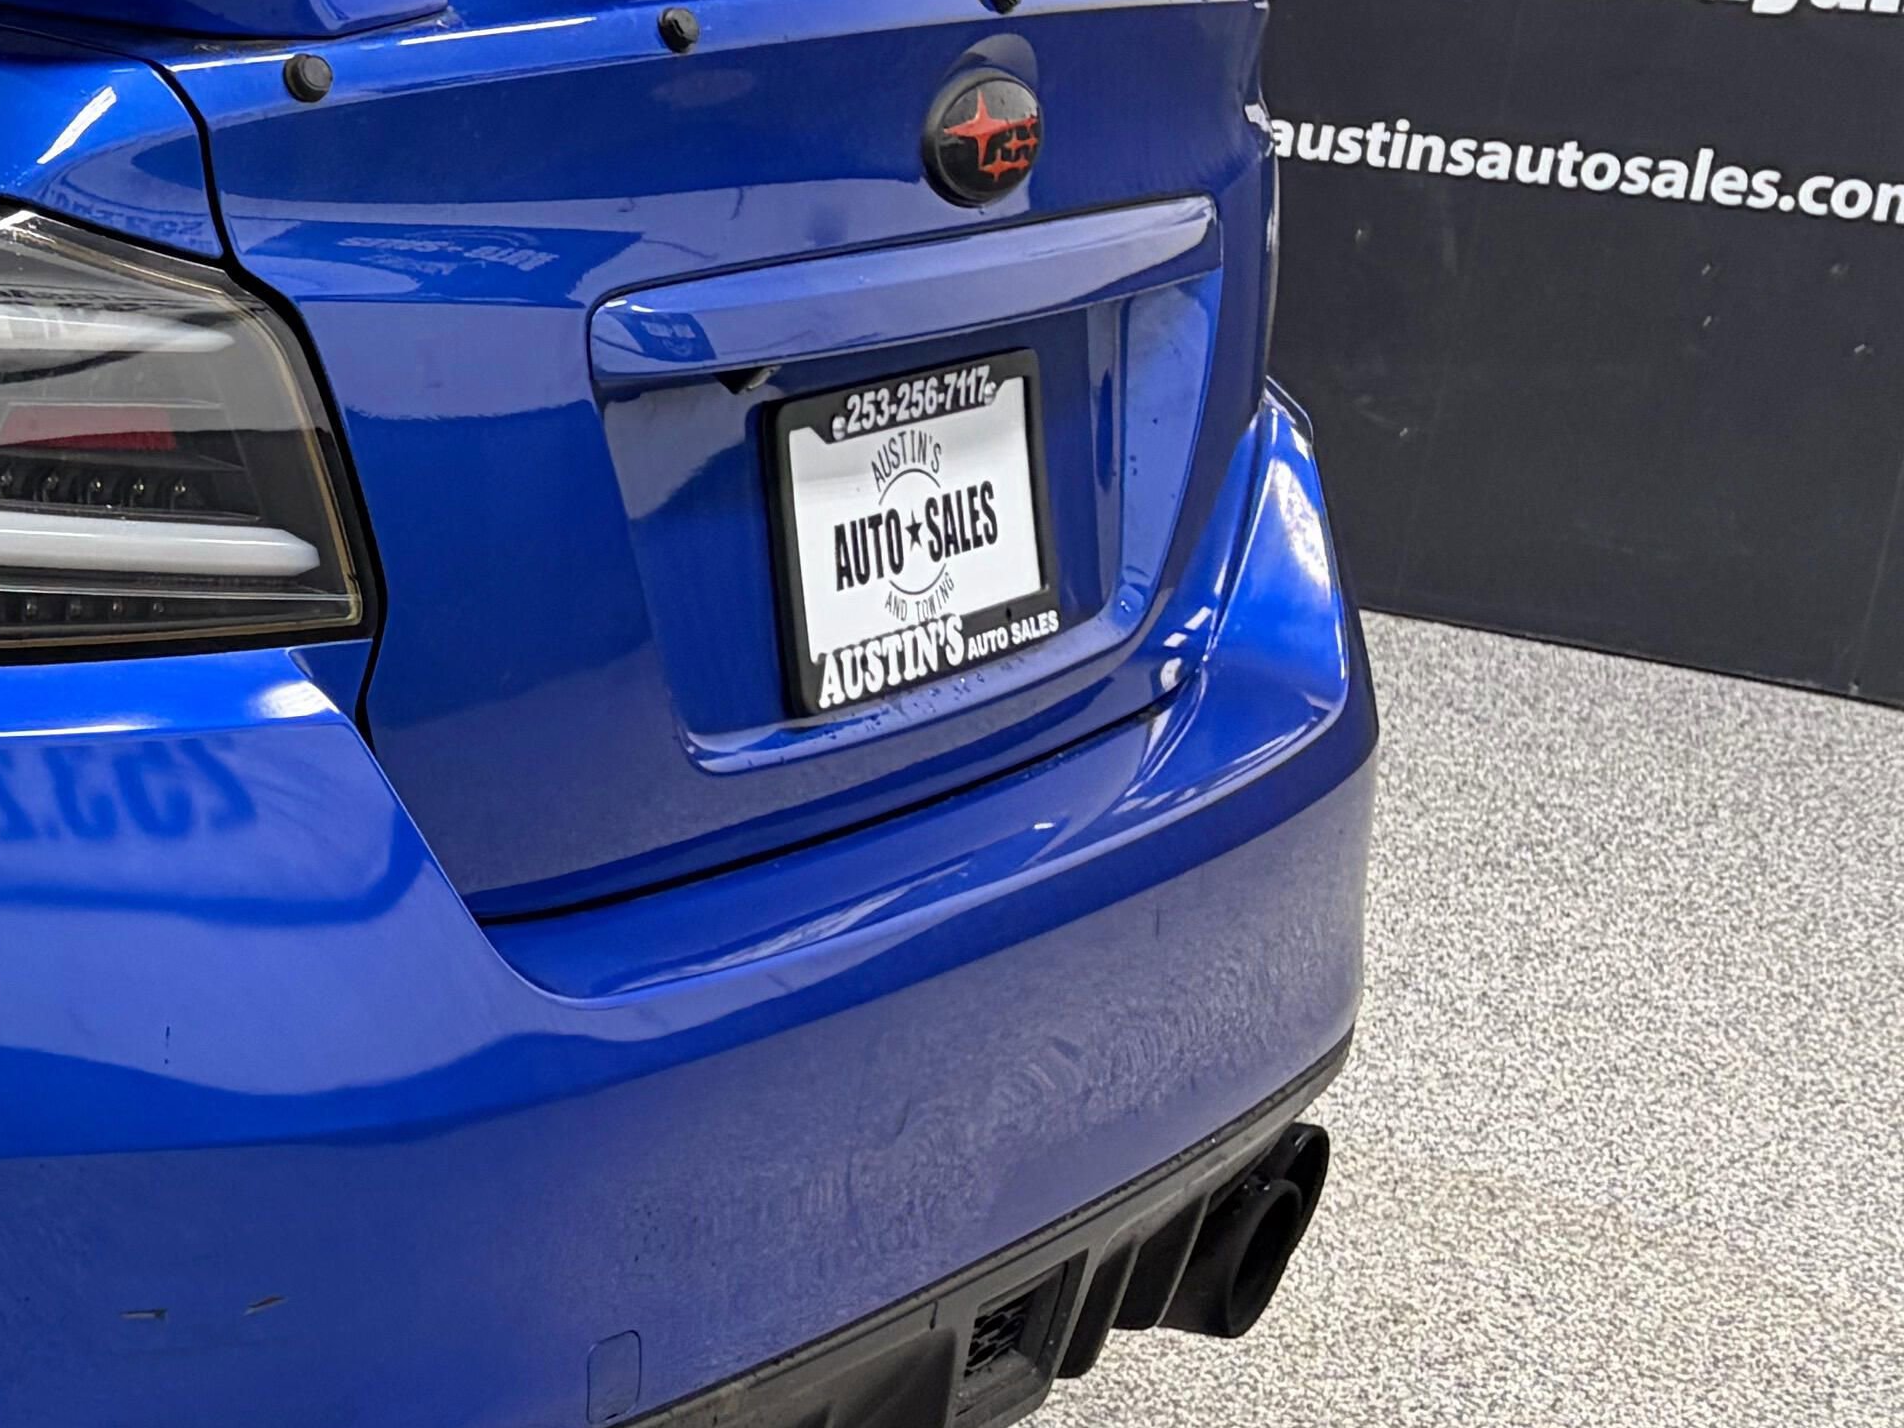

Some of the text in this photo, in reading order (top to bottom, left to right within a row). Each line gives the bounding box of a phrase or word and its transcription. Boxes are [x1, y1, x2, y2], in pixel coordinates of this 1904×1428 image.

[846, 364, 991, 434] 253-256-7117
[871, 429, 942, 493] AUSTIN'S
[834, 480, 998, 592] AUTO SALES
[884, 571, 955, 622] AND TOWING
[818, 609, 1060, 710] AUSTIN'S AUTO SALES
